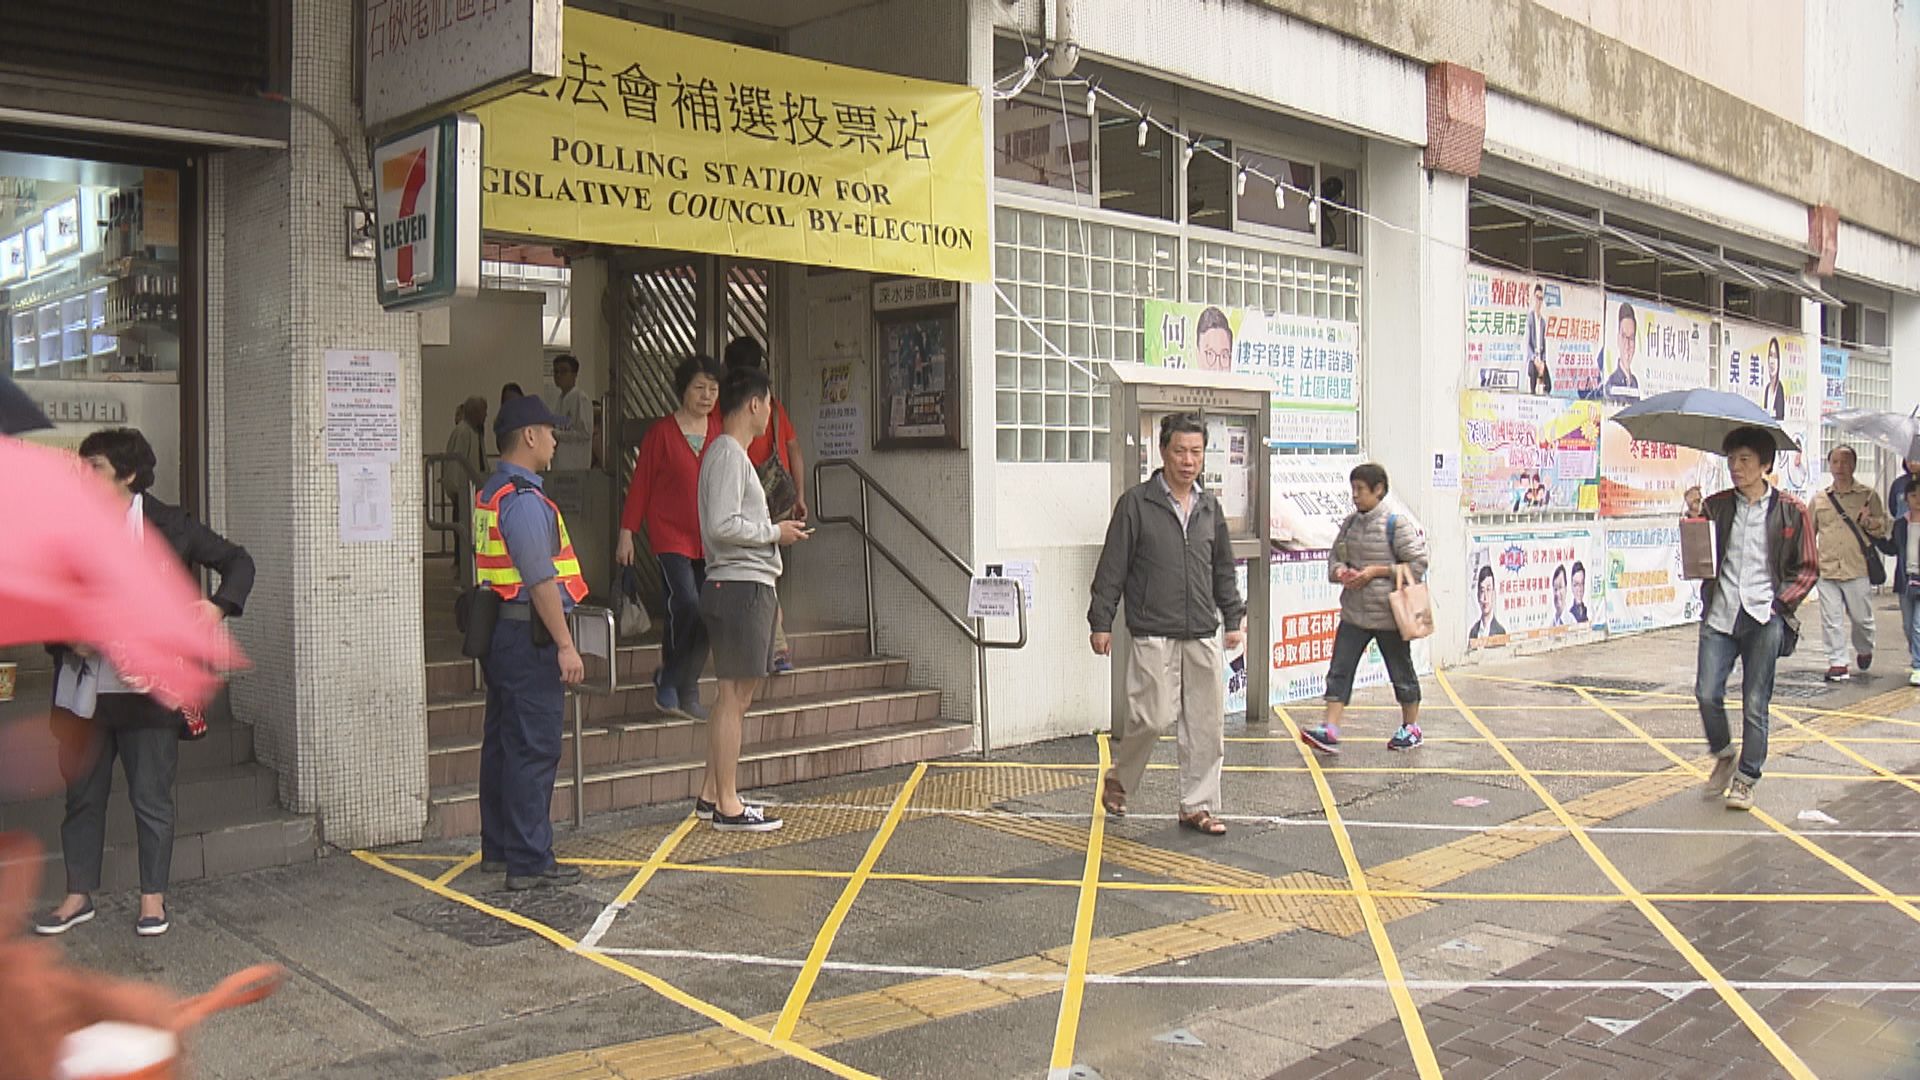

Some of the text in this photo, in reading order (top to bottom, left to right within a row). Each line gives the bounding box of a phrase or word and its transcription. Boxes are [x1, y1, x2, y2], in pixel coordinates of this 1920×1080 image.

[522, 51, 931, 162] 法會補選投票站
[552, 136, 892, 206] POLLING STATION FOR
[667, 190, 796, 229] COUNCIL
[808, 210, 975, 251] BY-ELECTION
[1236, 340, 1354, 373] 樓宇管理 法律諮詢
[1300, 373, 1352, 400] 社區問題
